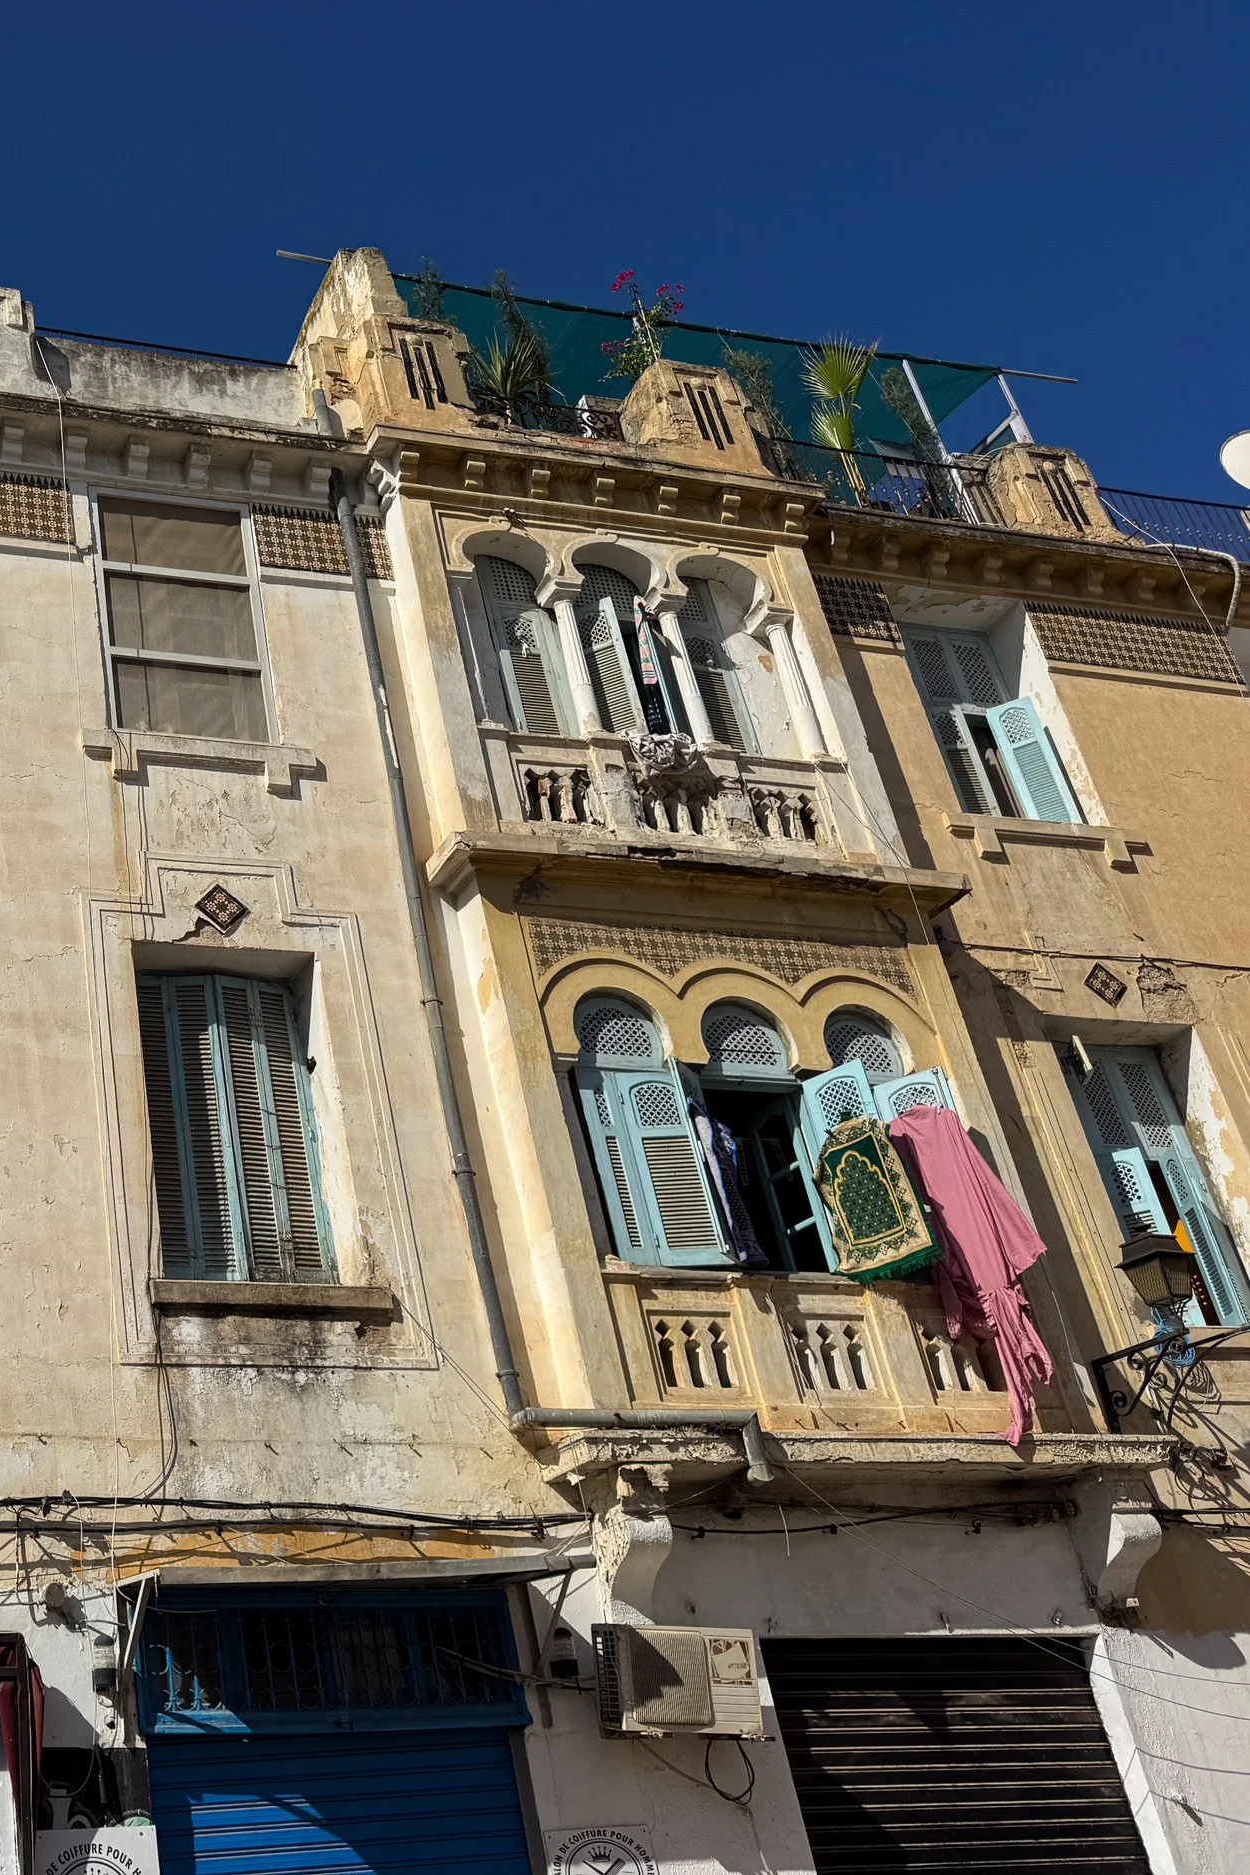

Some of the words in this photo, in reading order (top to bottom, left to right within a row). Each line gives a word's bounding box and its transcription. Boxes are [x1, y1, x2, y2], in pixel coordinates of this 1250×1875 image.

[559, 1843, 570, 1854] DE
[568, 1829, 607, 1845] COIFFURE
[610, 1830, 634, 1846] POUR
[58, 1843, 103, 1865] COIFFURE
[106, 1846, 133, 1869] POUR
